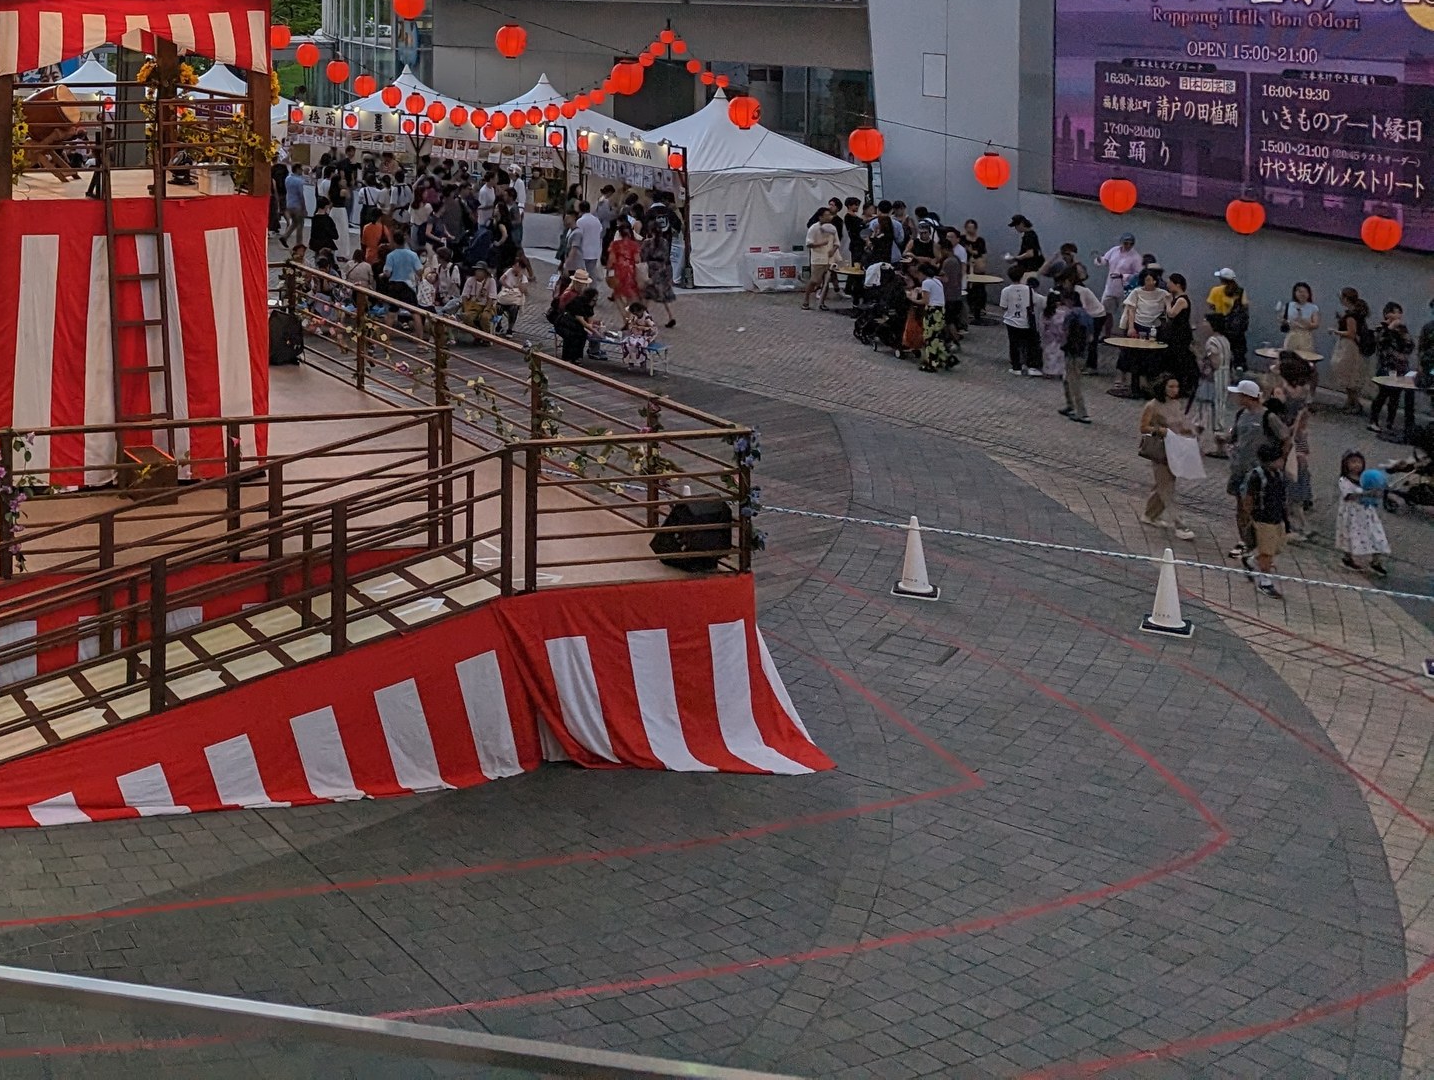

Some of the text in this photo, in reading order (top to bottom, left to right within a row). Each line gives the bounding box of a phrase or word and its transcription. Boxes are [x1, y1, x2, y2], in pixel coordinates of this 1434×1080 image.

[1153, 6, 1360, 30] Roppongi Hills Bon Odori
[1187, 40, 1227, 58] OPEN
[1179, 76, 1236, 94] 日本の芸能
[1302, 72, 1376, 85] 六本木けやき坂通り
[1102, 95, 1238, 128] 福島県浪江町 請戸の田植踊
[1261, 105, 1423, 143] いきものアート縁日
[611, 143, 652, 160] SHINANOYA
[1100, 136, 1171, 166] 盆踊り
[1259, 156, 1425, 198] けやき坂グルメストリート
